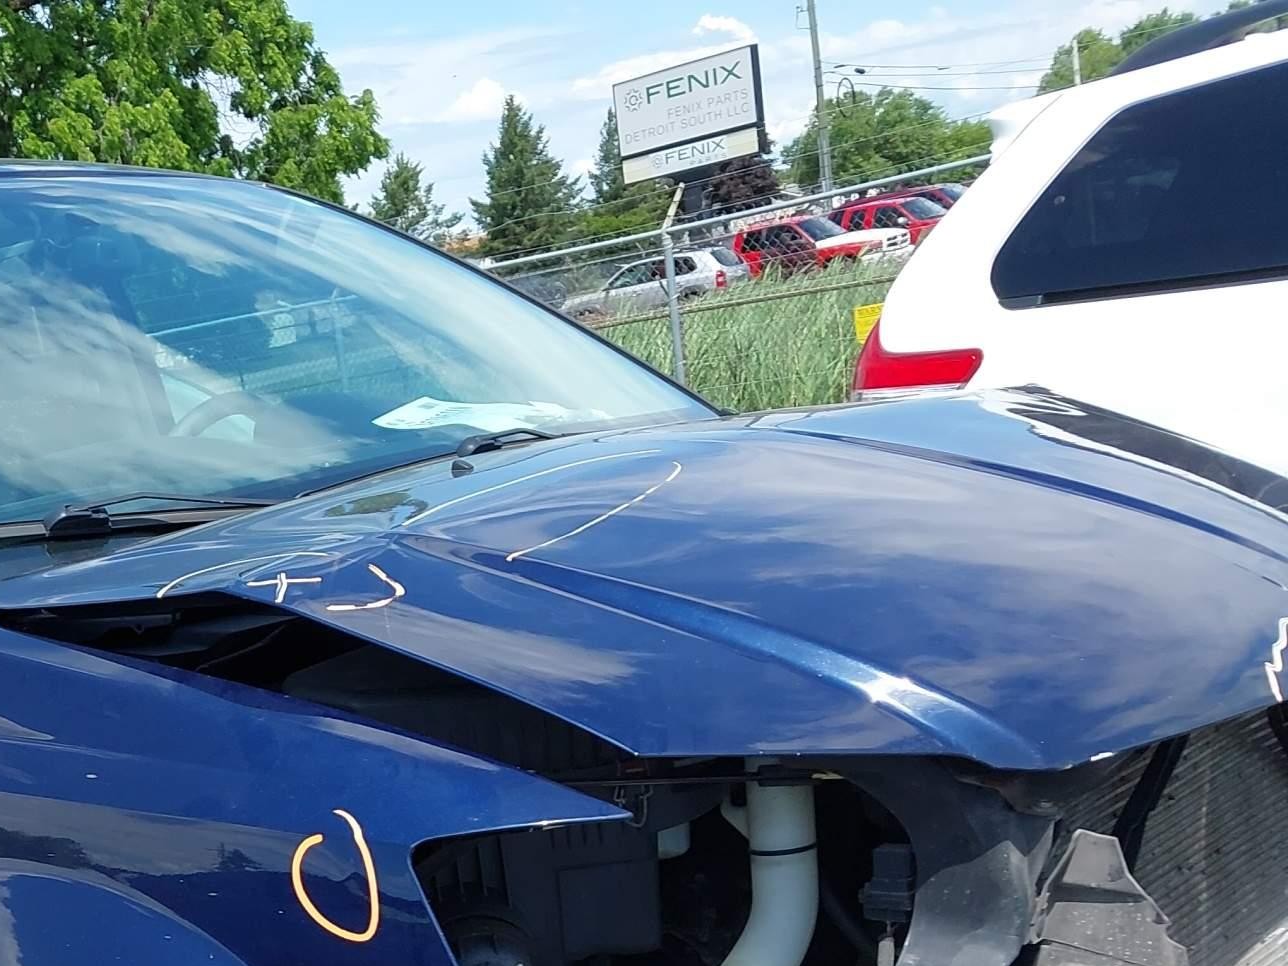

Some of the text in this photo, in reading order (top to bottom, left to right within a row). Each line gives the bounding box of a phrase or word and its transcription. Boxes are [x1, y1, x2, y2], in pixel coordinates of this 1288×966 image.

[646, 61, 743, 104] FENIX
[667, 88, 749, 119] FENIX PARTS
[625, 103, 750, 145] DETROIT SOUTH LLC
[665, 139, 726, 164] FENIX
